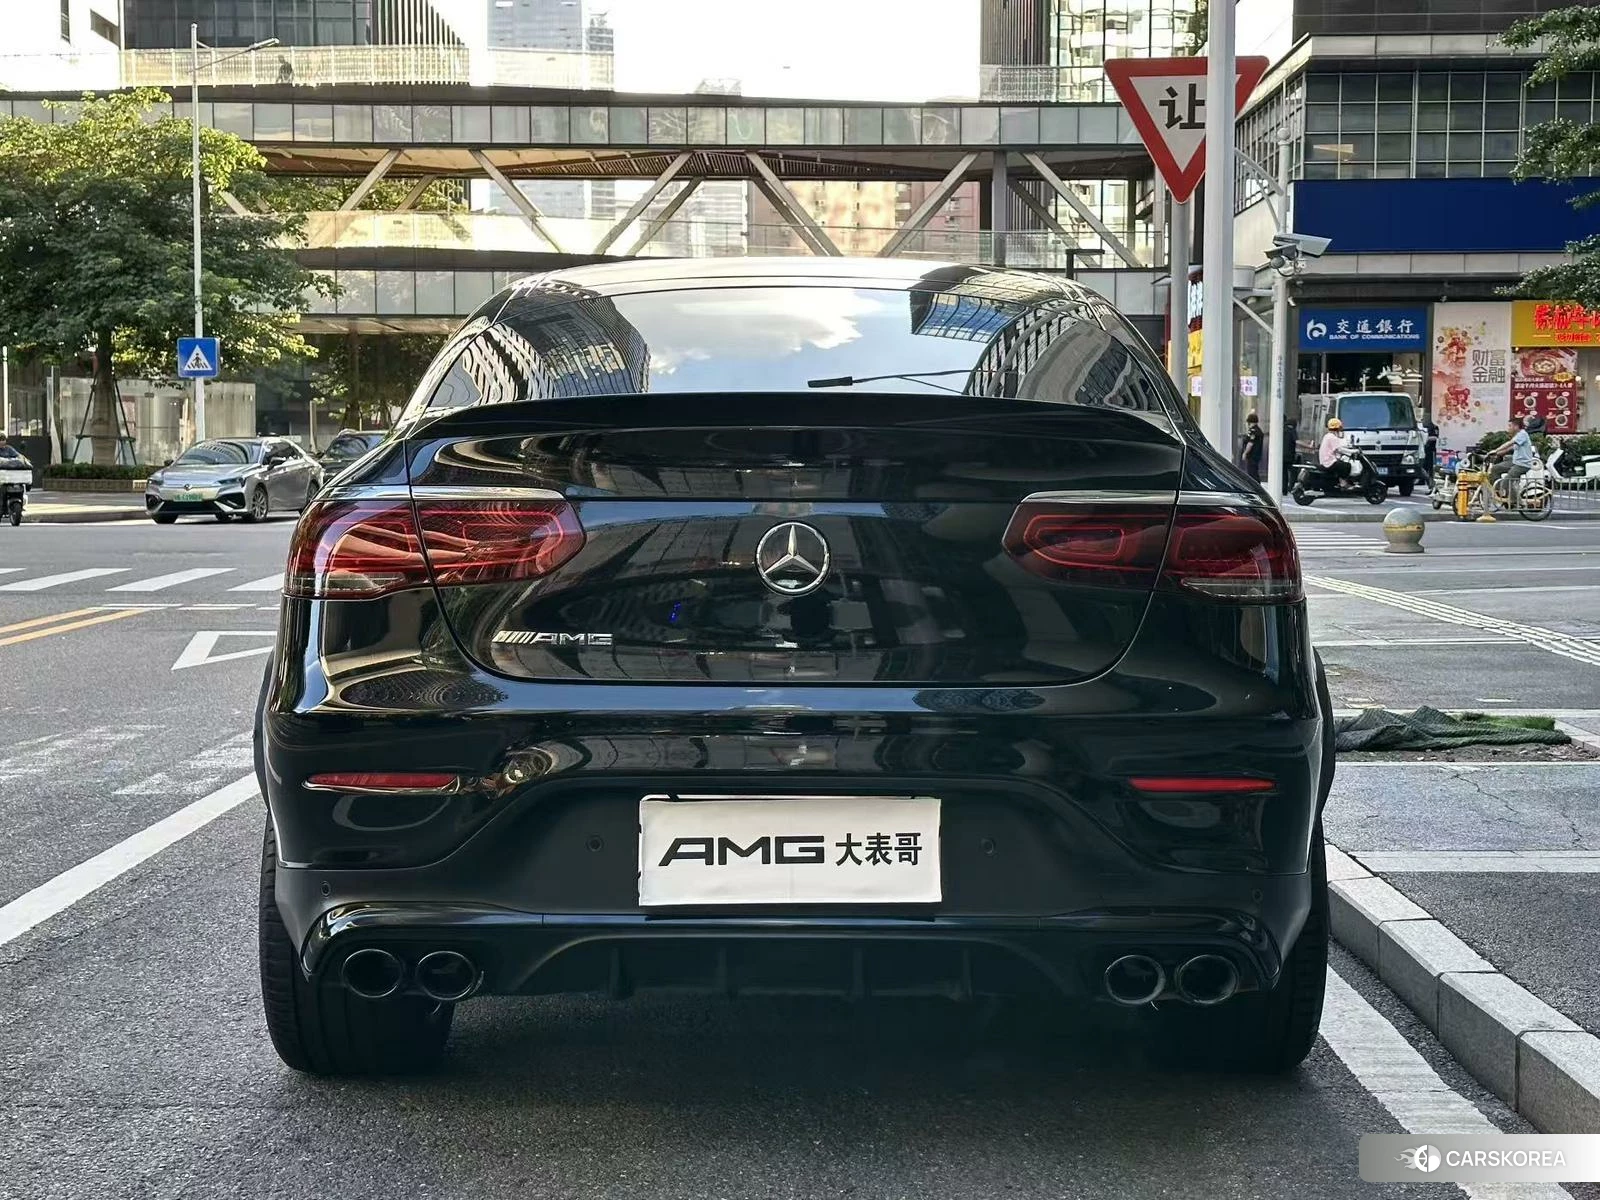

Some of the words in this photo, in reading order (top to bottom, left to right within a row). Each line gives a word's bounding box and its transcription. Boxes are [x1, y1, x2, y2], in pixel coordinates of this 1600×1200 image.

[1159, 83, 1205, 129] 让
[1472, 349, 1506, 366] 财富
[1472, 366, 1506, 384] 金融
[530, 631, 613, 645] AMG
[658, 835, 825, 867] AMG
[836, 831, 922, 867] 大表哥
